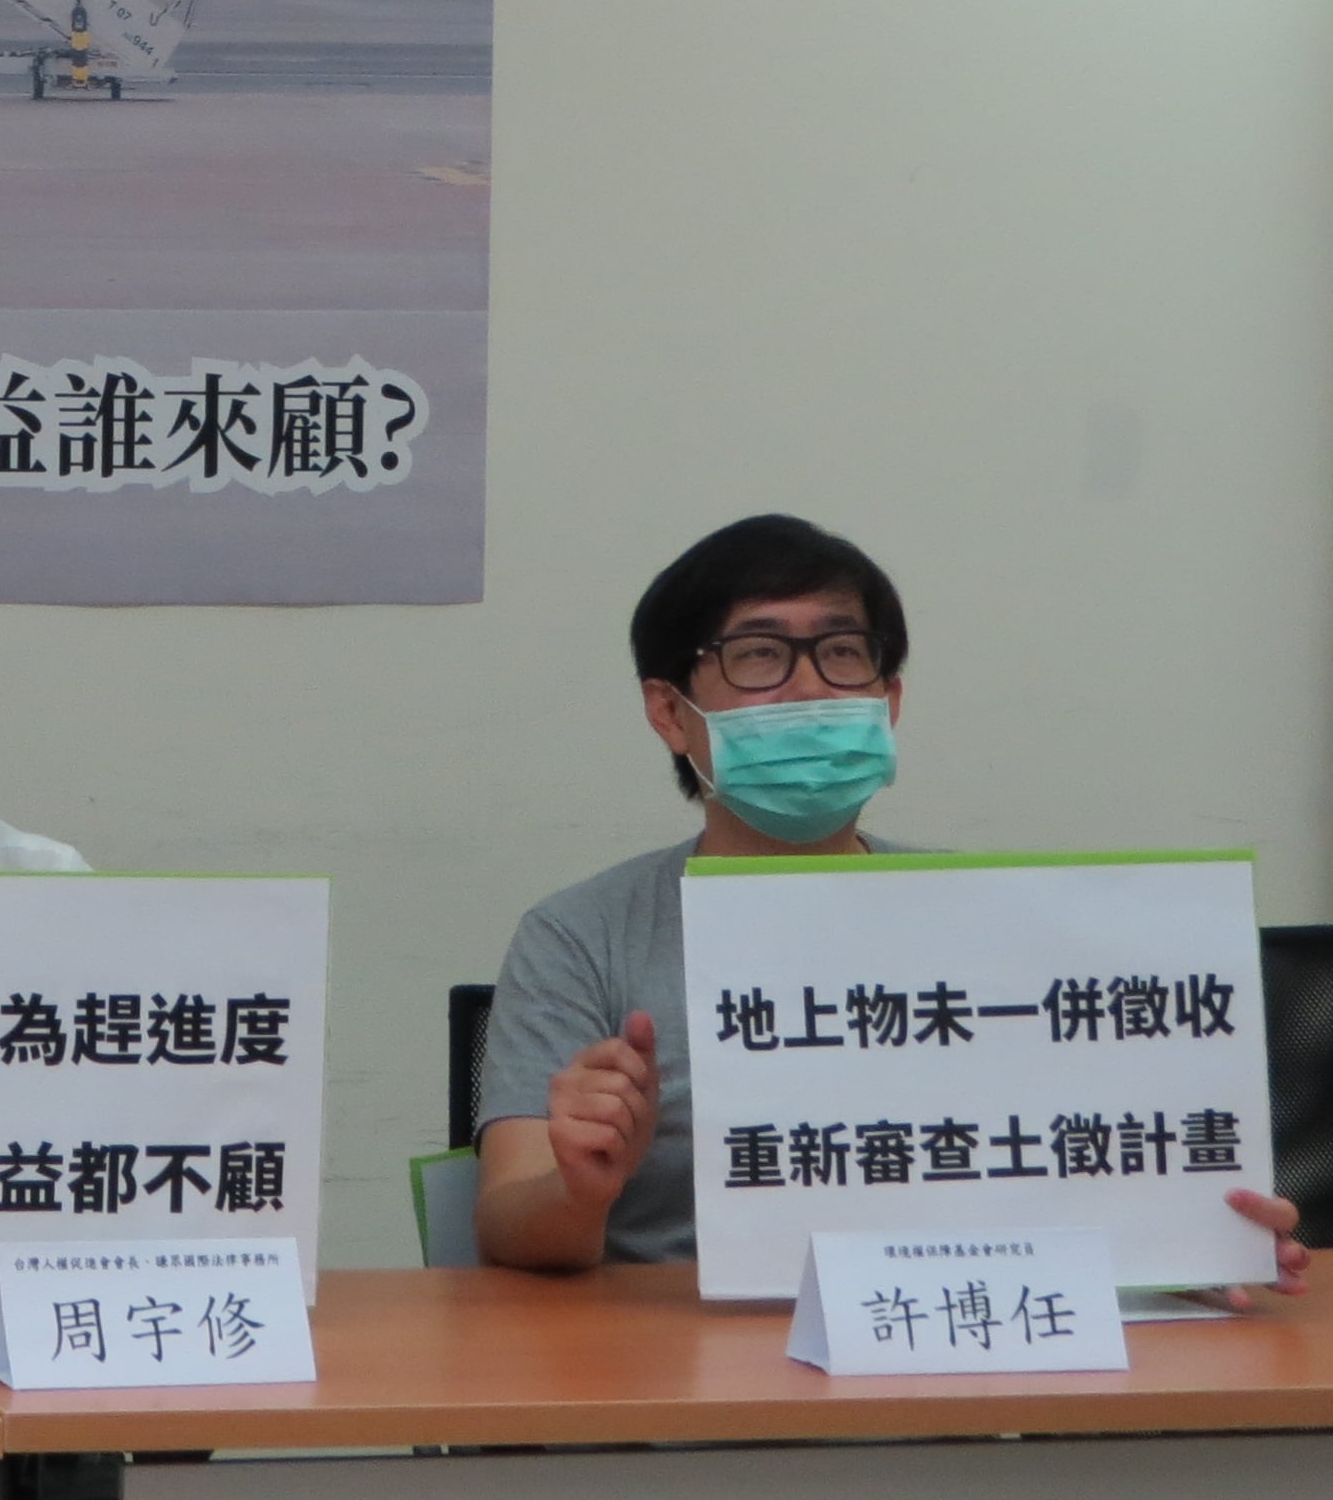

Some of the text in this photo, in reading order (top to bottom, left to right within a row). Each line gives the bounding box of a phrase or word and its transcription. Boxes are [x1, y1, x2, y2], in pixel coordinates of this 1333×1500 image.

[715, 973, 1235, 1051] 地上物未一併徵收
[723, 1108, 1242, 1188] 重新審查土徵計畫
[51, 1291, 265, 1363] 周宇修
[861, 1280, 1076, 1351] 許博任
